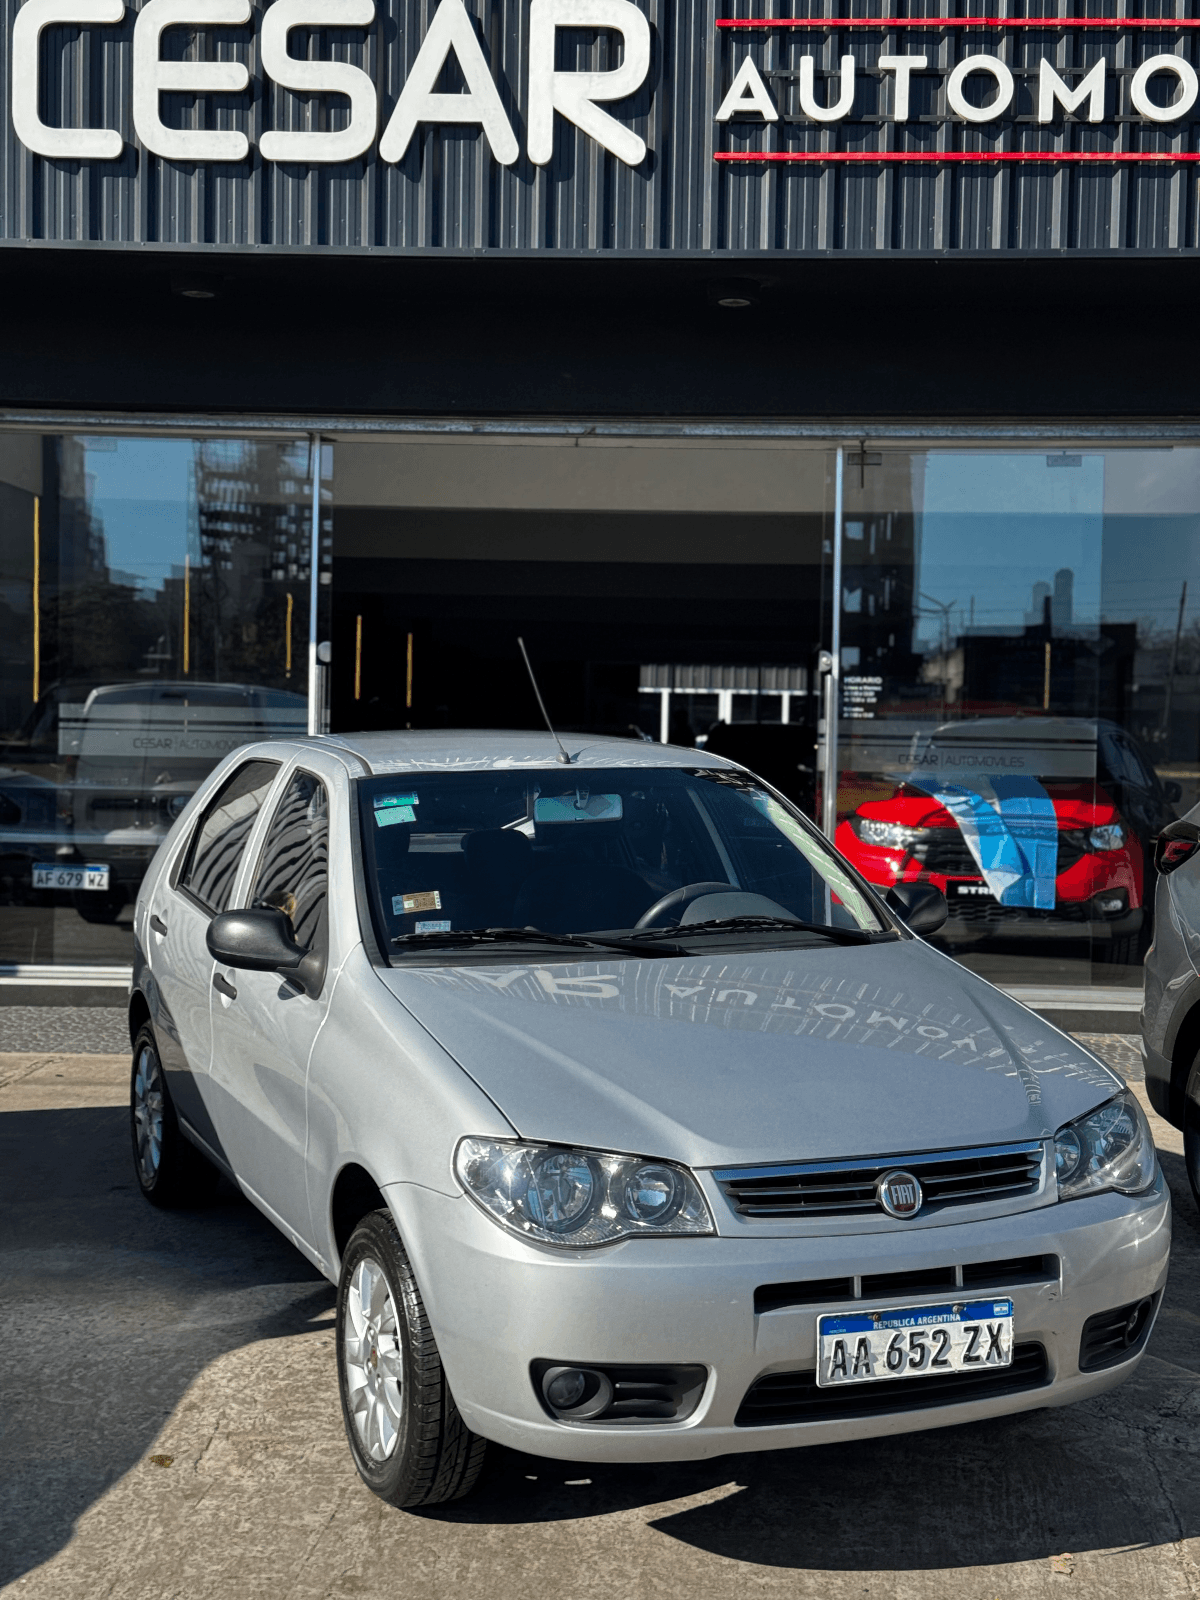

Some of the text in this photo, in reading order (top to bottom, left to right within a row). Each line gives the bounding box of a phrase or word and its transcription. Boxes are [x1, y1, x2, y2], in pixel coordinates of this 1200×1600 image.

[12, 0, 651, 165] CESAR
[714, 53, 1199, 123] AUTOMO
[133, 738, 172, 749] CESAR
[897, 754, 1026, 767] CESAR AUTOMOVILES
[36, 871, 53, 884] AF
[57, 872, 83, 886] 679
[891, 1184, 914, 1205] FIAT
[917, 1313, 961, 1325] ARGENTINA
[830, 1322, 1004, 1379] AA 652 ZX
